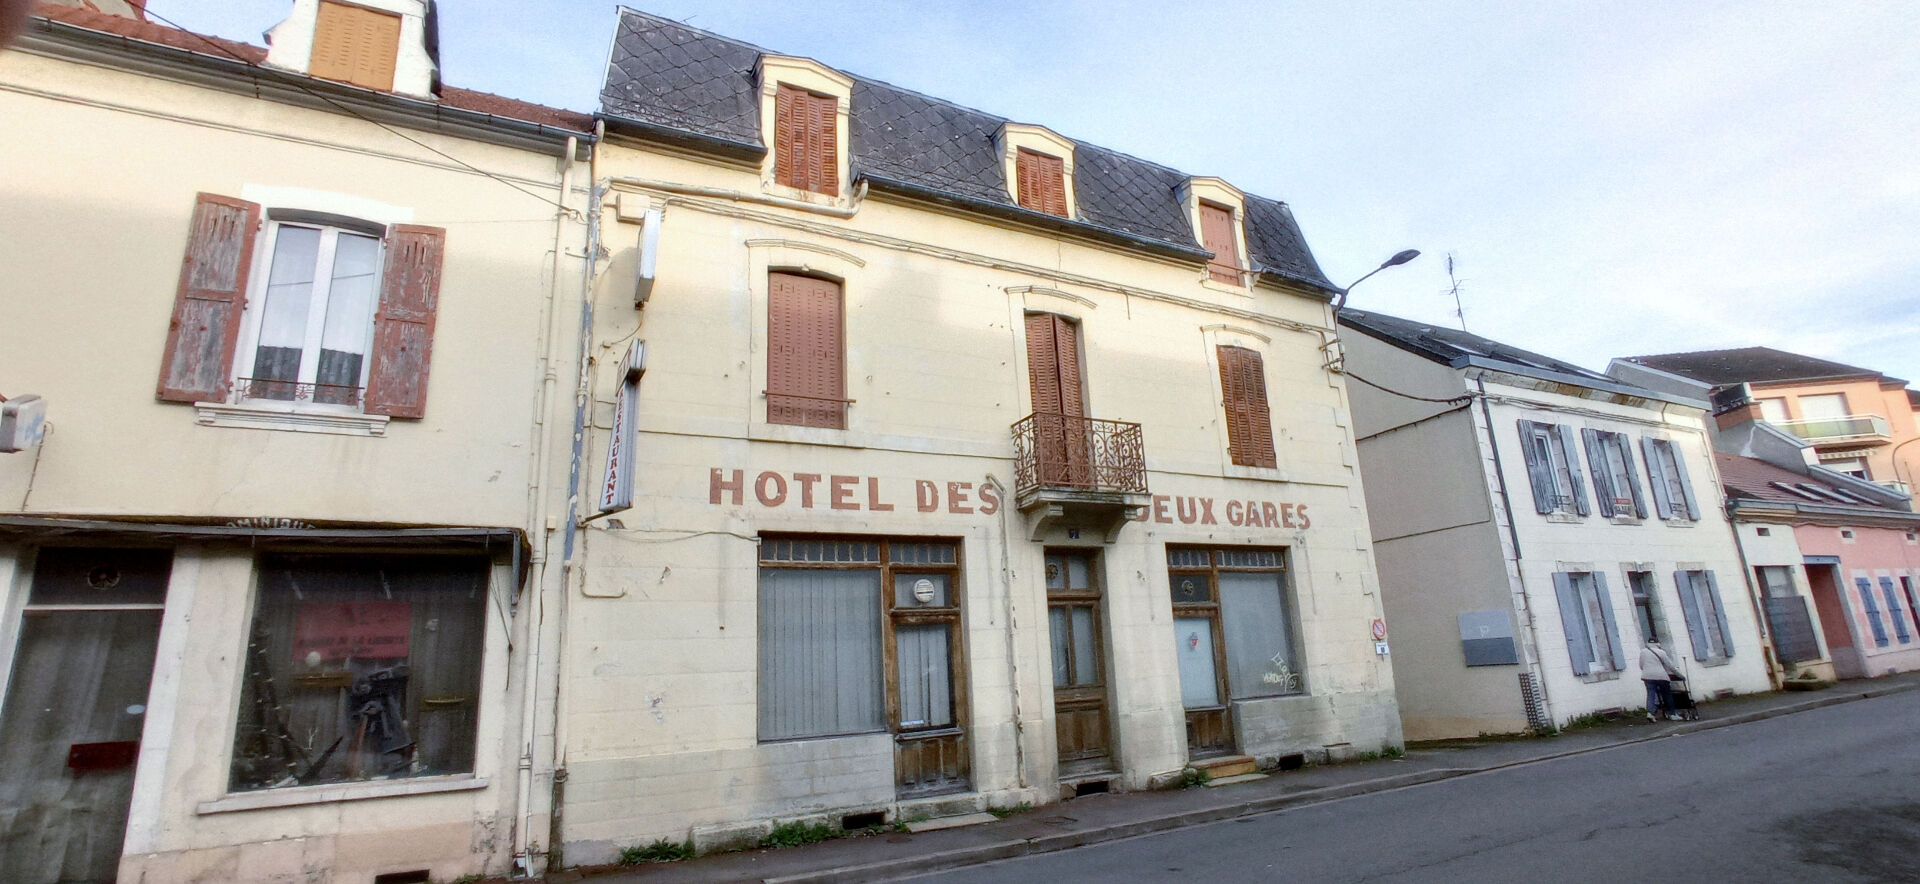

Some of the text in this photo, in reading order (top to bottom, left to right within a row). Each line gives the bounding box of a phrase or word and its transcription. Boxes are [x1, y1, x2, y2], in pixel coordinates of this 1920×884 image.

[709, 467, 895, 511] HOTEL
[915, 479, 999, 515] DES
[1226, 499, 1312, 530] GARES
